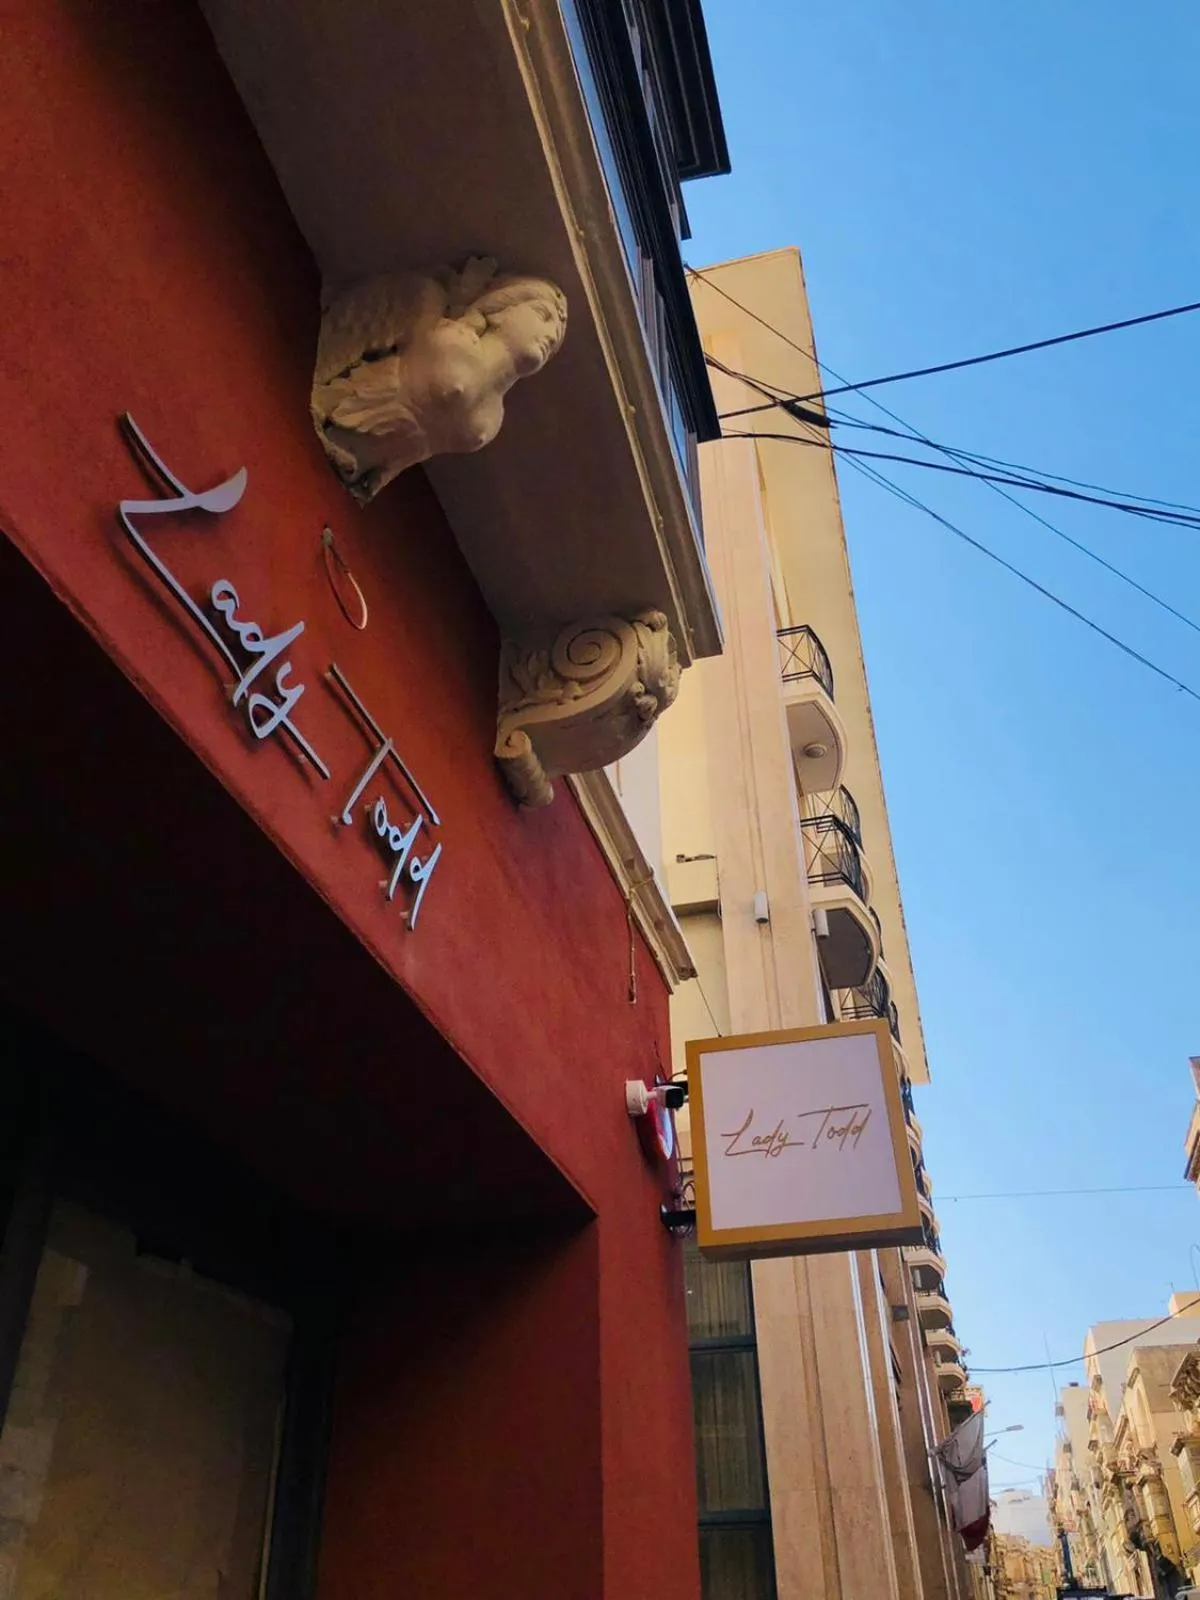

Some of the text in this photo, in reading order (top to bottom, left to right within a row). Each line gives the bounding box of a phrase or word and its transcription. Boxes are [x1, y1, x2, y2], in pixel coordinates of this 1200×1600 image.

[121, 411, 441, 932] Lady Todd
[721, 1103, 872, 1158] Lady Todd
